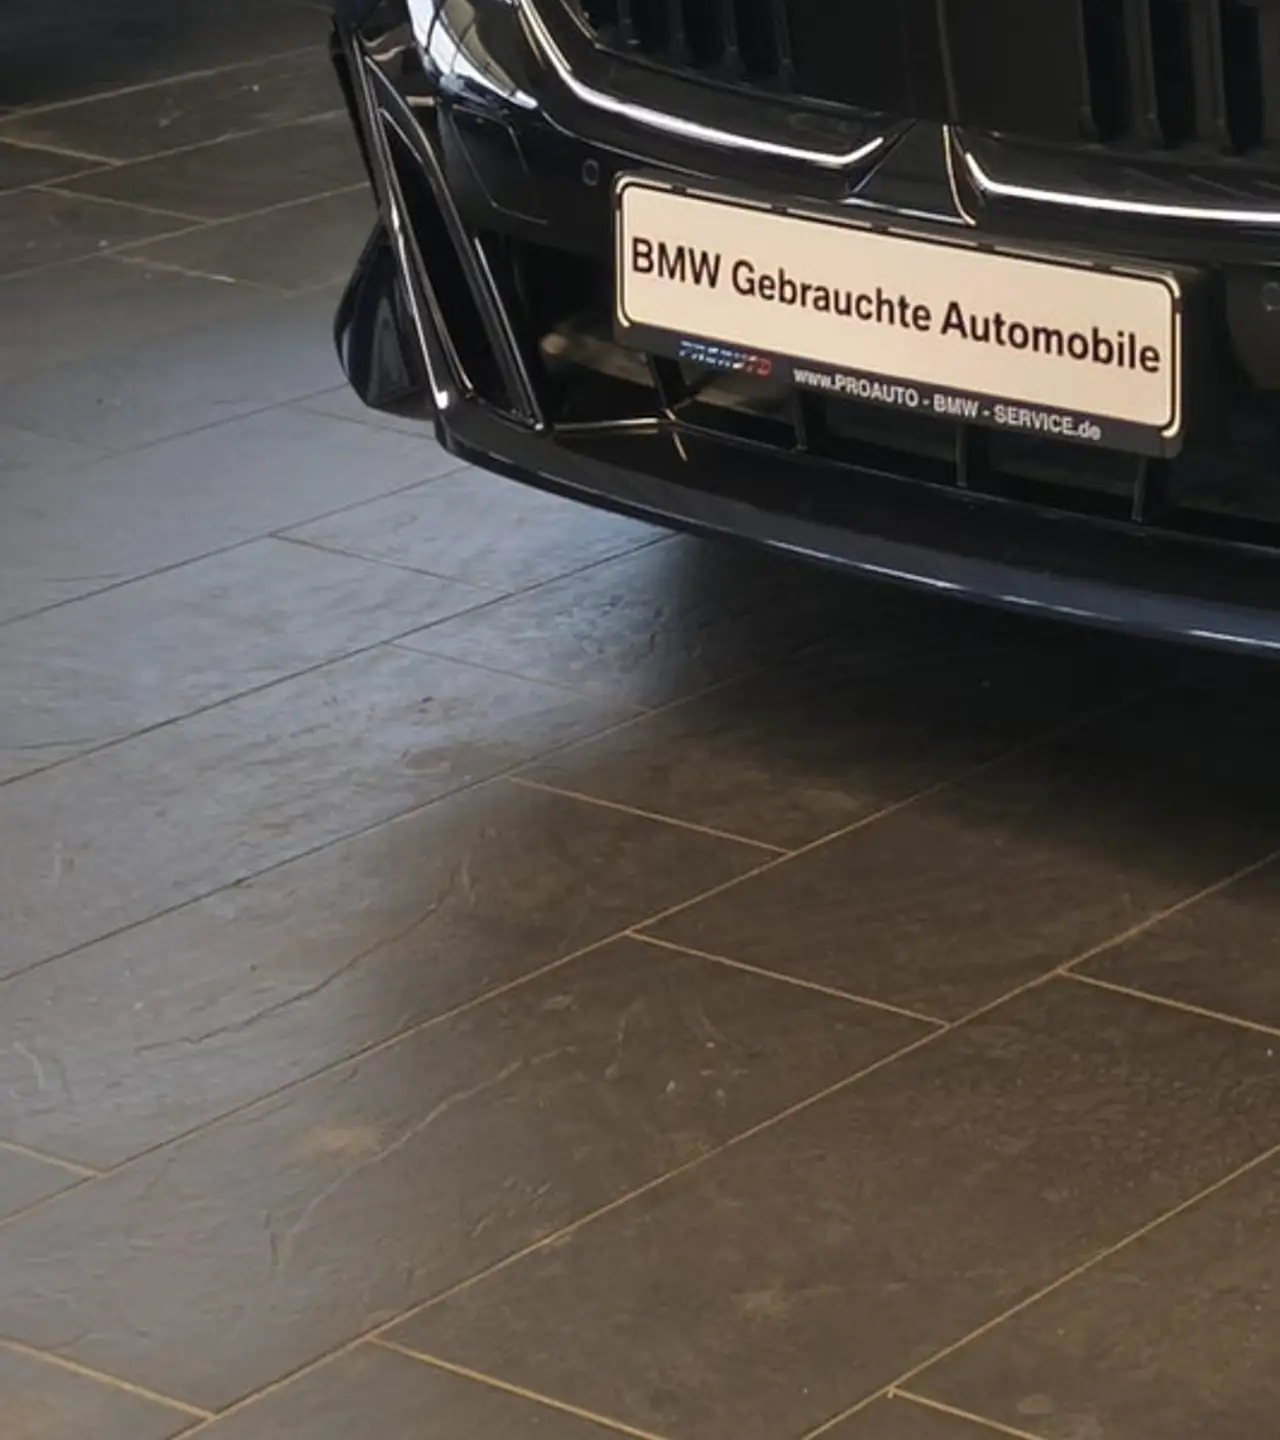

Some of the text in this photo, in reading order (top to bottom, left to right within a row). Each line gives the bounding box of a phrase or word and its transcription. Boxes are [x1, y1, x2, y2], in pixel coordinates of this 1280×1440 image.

[632, 236, 1161, 373] BMW Gebrauchte Automobile
[793, 367, 919, 408] www.PROAUTO
[933, 393, 980, 419] BMW
[994, 403, 1101, 441] SERVICE.de
